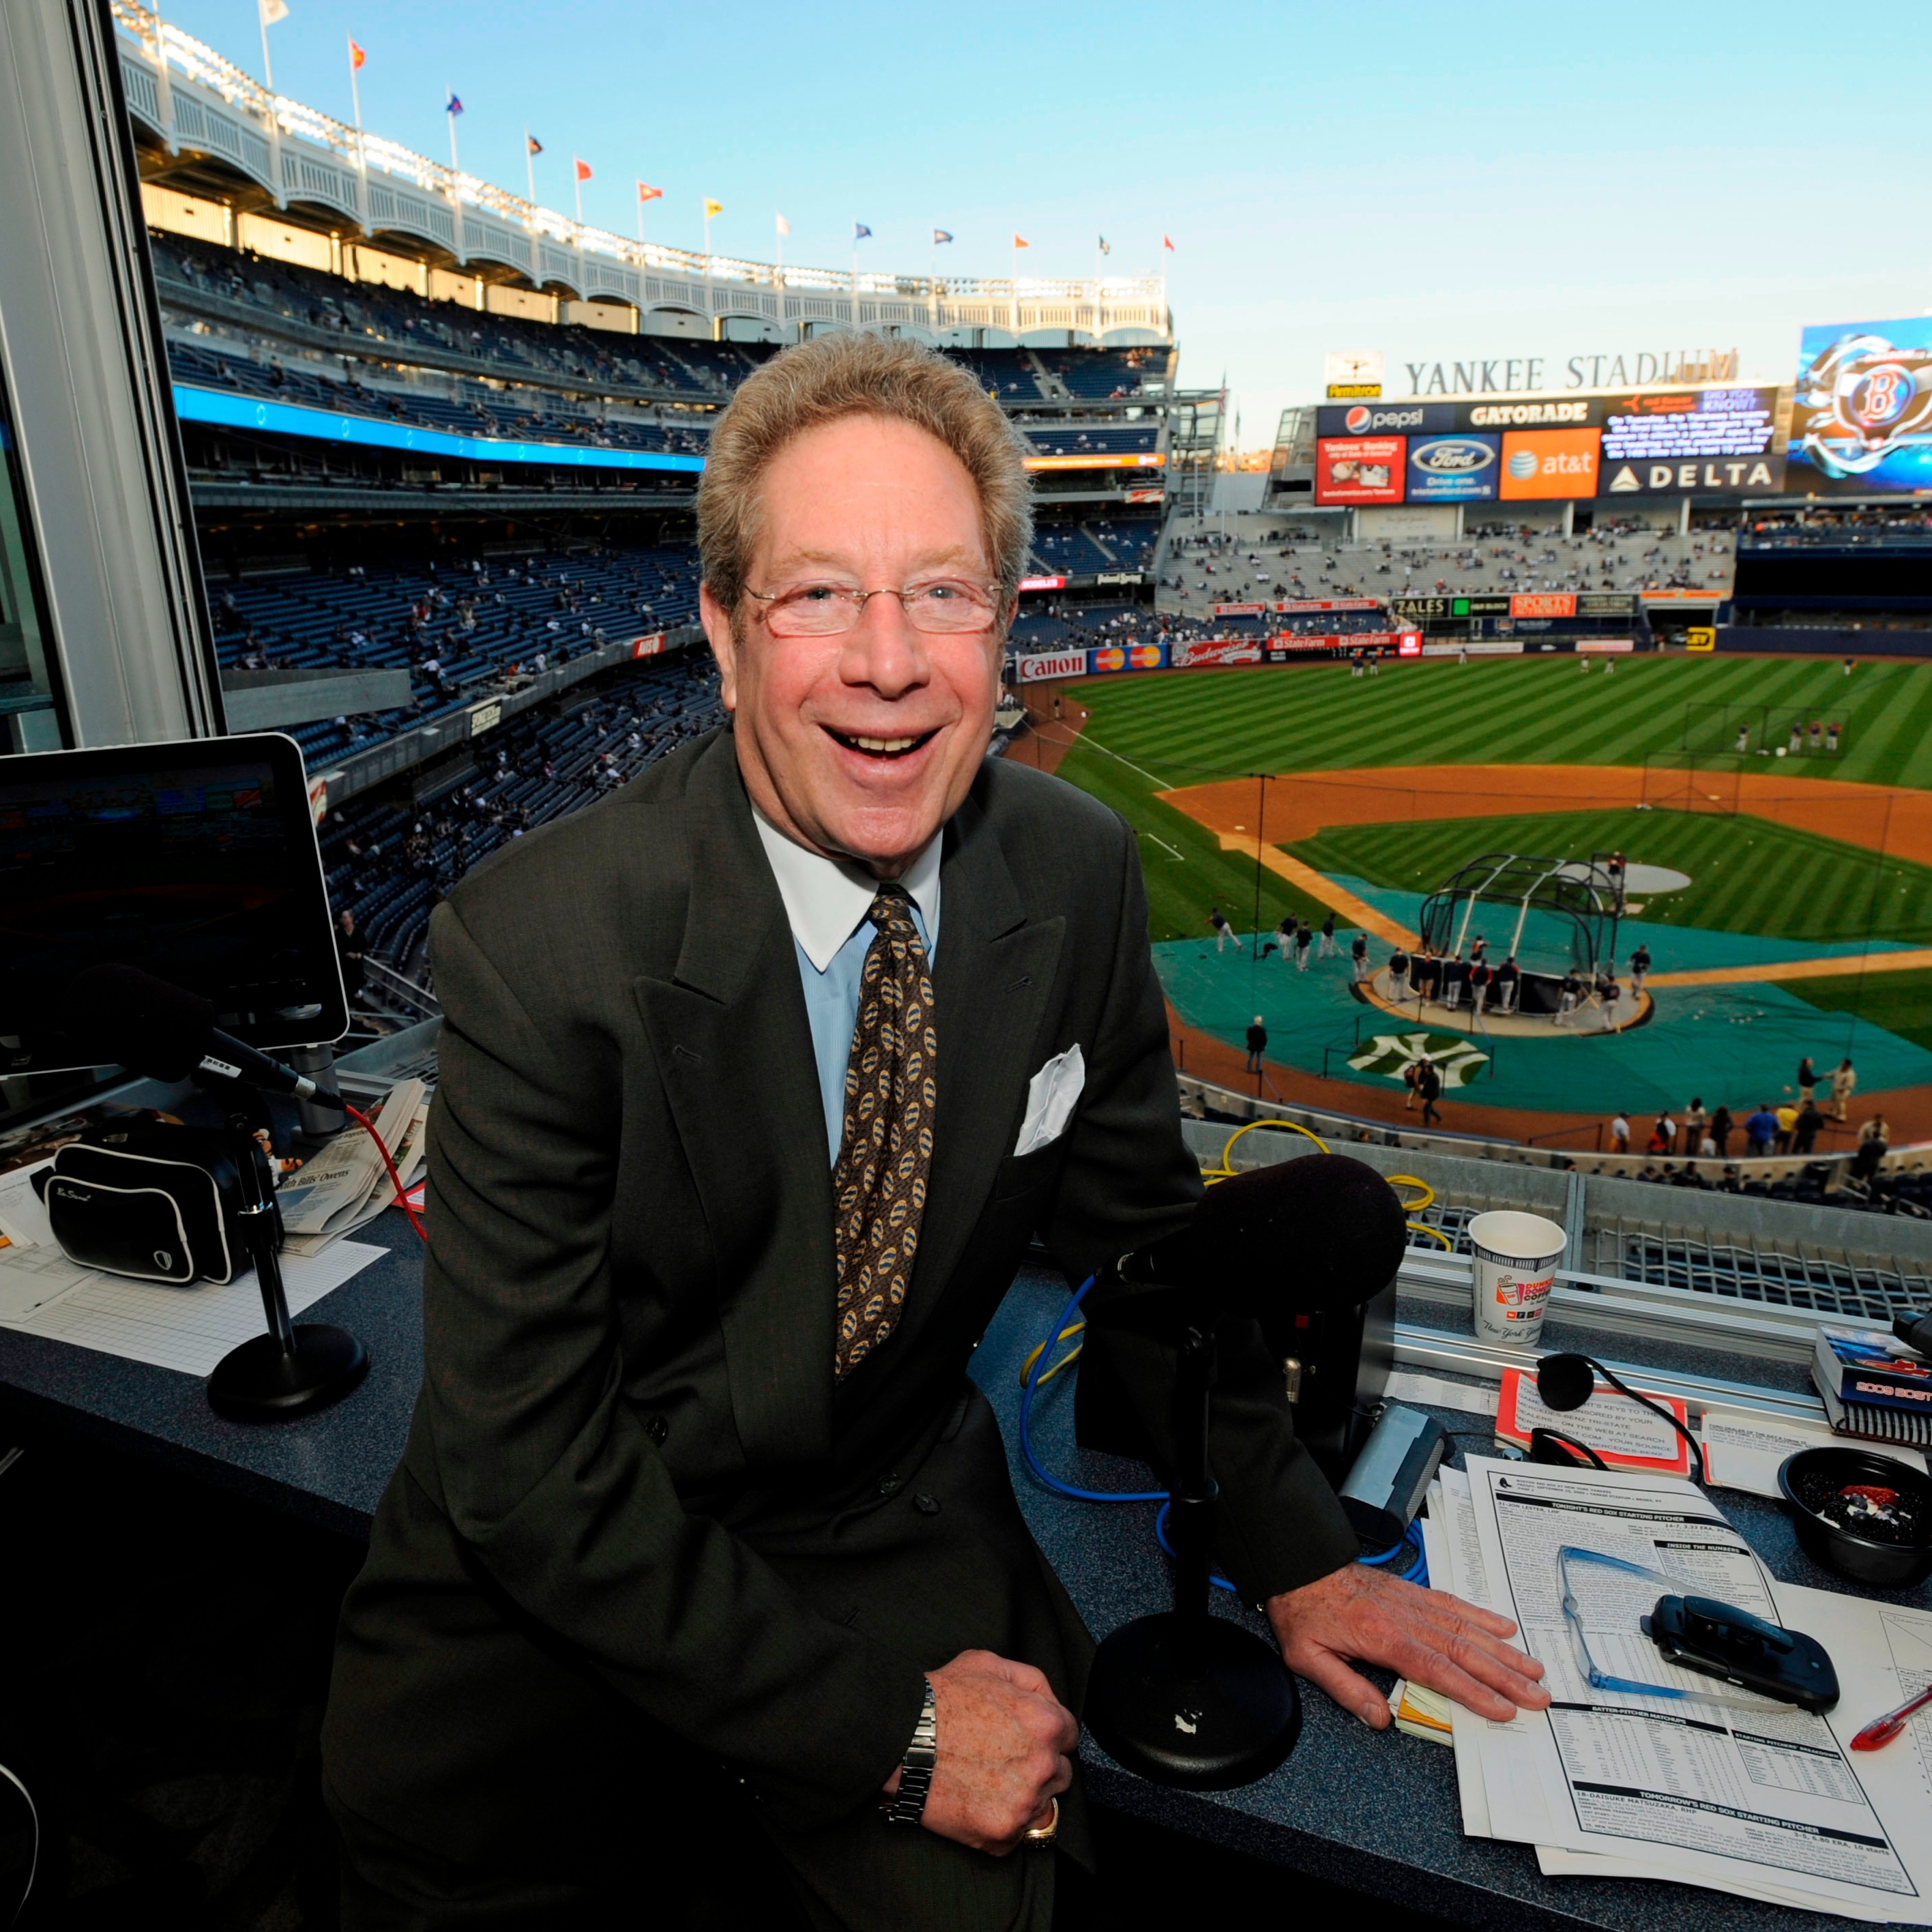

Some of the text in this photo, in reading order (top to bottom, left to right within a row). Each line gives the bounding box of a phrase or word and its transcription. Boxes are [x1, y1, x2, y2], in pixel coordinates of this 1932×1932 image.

[1405, 347, 1739, 395] YANKEE STADIUM
[1372, 408, 1424, 429] pepsi
[1470, 402, 1589, 426] GATORADE
[1429, 446, 1476, 467] Ford
[1542, 450, 1593, 475] at&t
[1649, 463, 1772, 488] DELTA
[1397, 599, 1445, 613] ZALES
[1516, 596, 1571, 607] SPORTS
[1177, 639, 1249, 667] Budweiser
[1020, 655, 1083, 678] Canon
[319, 1169, 351, 1182] Owens
[1501, 1328, 1523, 1339] York
[1856, 1381, 1894, 1396] 2009
[1518, 1393, 1540, 1404] GAME
[1571, 1408, 1612, 1419] ONSORED
[1628, 1417, 1654, 1425] YOUR
[1605, 1405, 1626, 1413] KEYS
[1517, 1407, 1553, 1422] DEALERS
[1594, 1427, 1615, 1435] WEB
[1629, 1433, 1665, 1444] SEARCH
[1588, 1419, 1631, 1430] TRI-STATE
[1562, 1428, 1579, 1436] DOT
[1582, 1433, 1602, 1441] COM
[1609, 1438, 1633, 1447] YOUR
[1635, 1441, 1672, 1452] SOURCE
[1522, 1505, 1546, 1513] LESTER,
[1551, 1502, 1588, 1513] TONIGHT'S
[1619, 1512, 1653, 1521] STARTING
[1654, 1514, 1684, 1523] PITCHER
[1708, 1545, 1740, 1553] NUMBERS
[1592, 1706, 1649, 1718] BATTER-PITCHER
[1650, 1712, 1687, 1725] MATCHUPS
[1577, 1791, 1625, 1802] 18-DAISUKE
[1628, 1798, 1678, 1812] MATSUZAKA,
[1639, 1791, 1820, 1834] TOMORROW'S RED SOX STARTING PITCHER
[1794, 1832, 1809, 1840] 3-5,
[1812, 1835, 1830, 1844] 6.80
[1832, 1840, 1851, 1849] ERA,
[1866, 1847, 1890, 1856] starts
